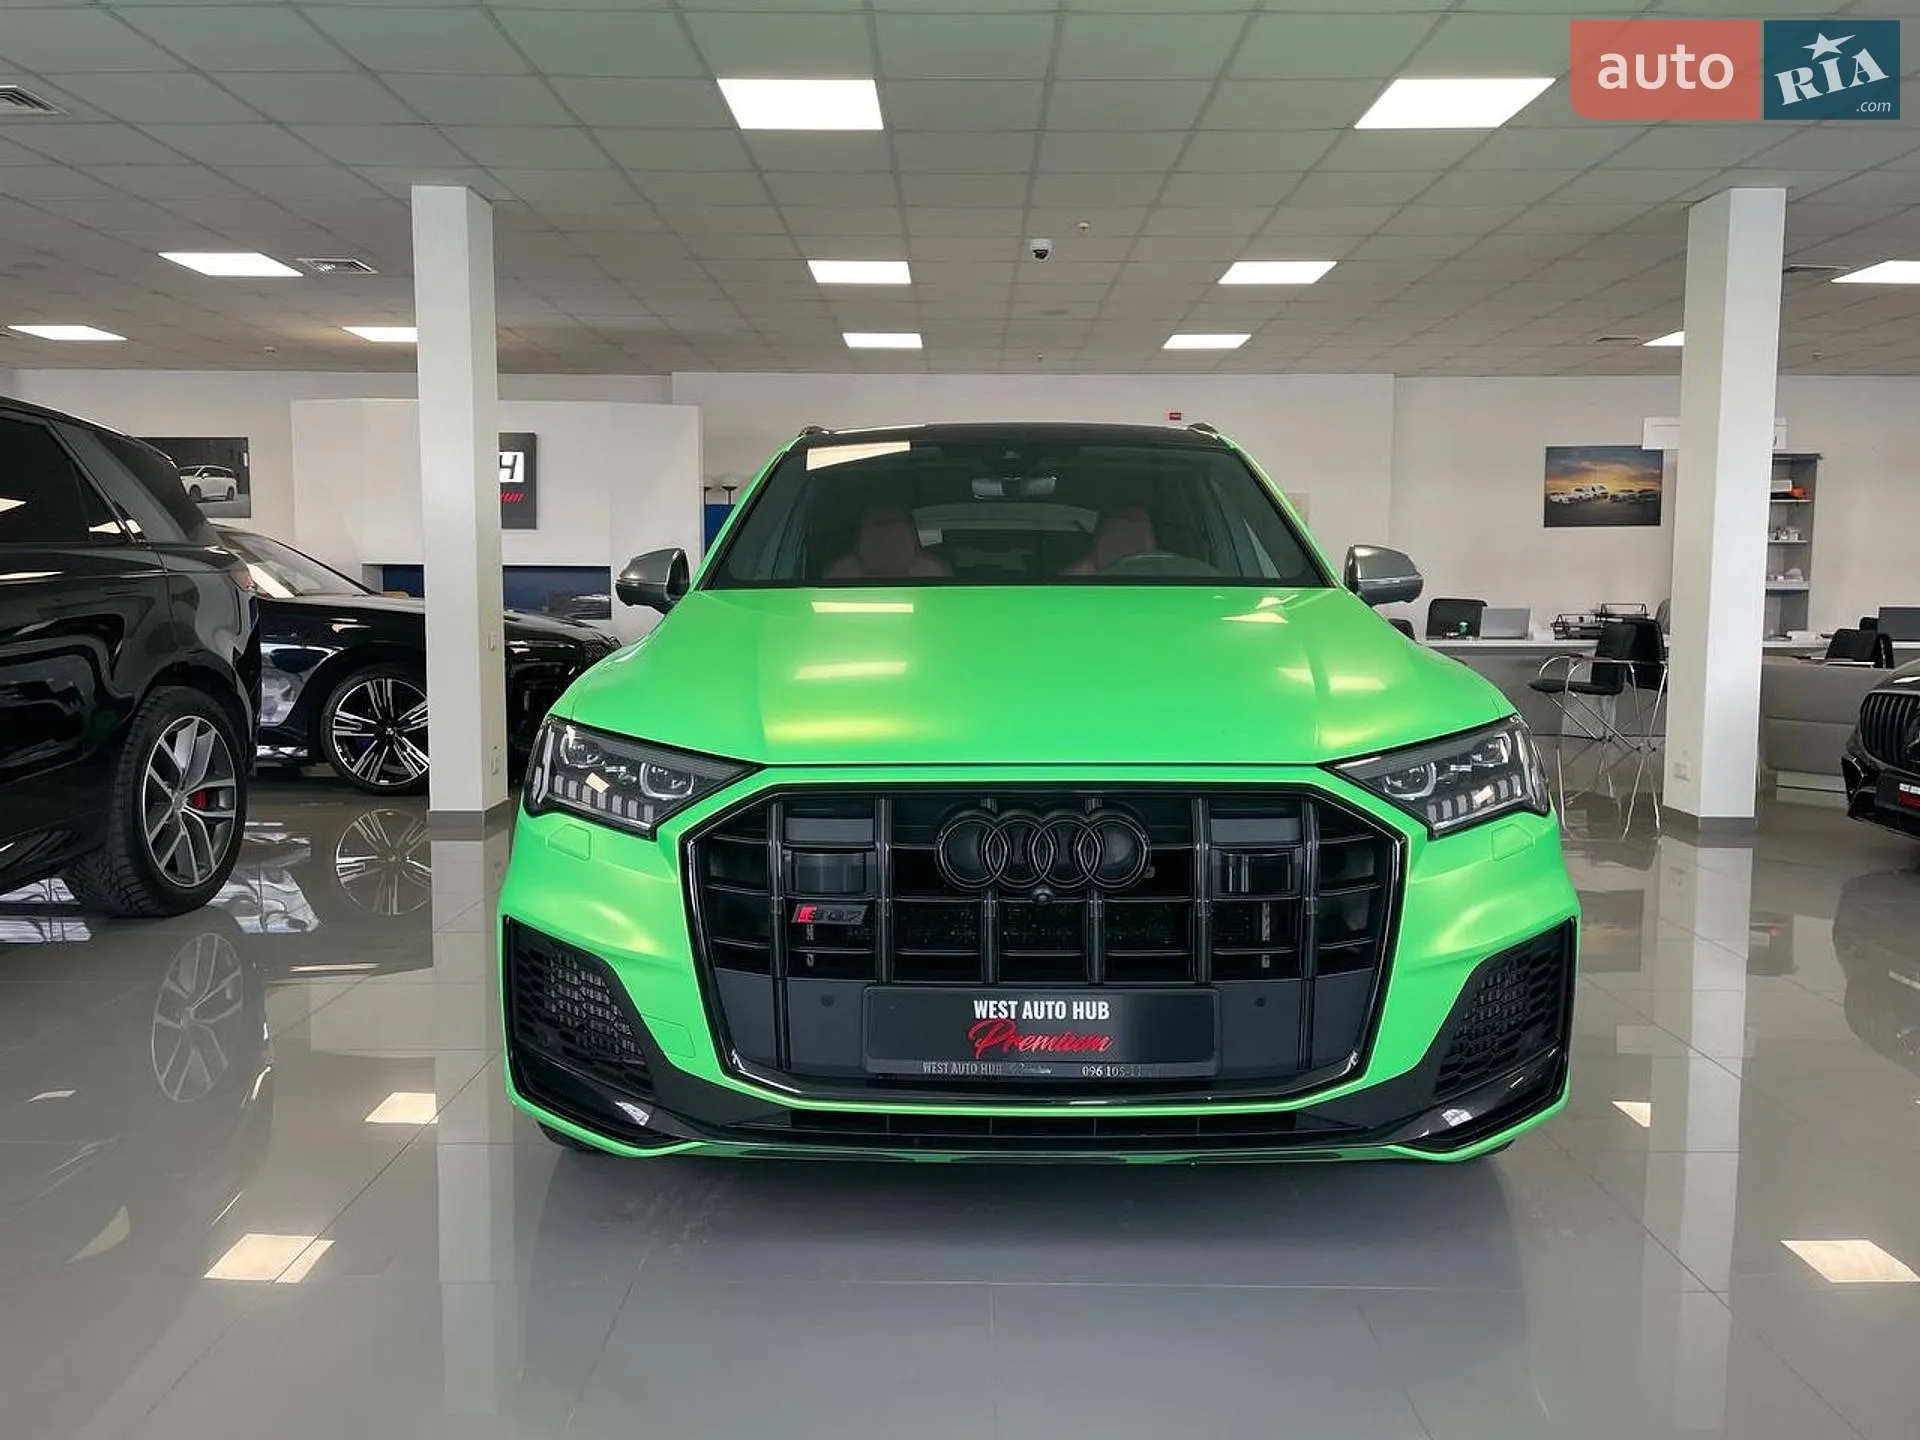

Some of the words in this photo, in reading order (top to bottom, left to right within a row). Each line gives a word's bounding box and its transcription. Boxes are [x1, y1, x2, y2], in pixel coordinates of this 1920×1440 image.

[974, 1000, 1018, 1020] WEST
[1022, 1000, 1067, 1020] AUTO
[1072, 1000, 1110, 1020] HUB
[968, 1018, 1114, 1060] Premium
[922, 1061, 948, 1074] WEST
[950, 1062, 978, 1075] AUTO
[1081, 1065, 1104, 1077] 096
